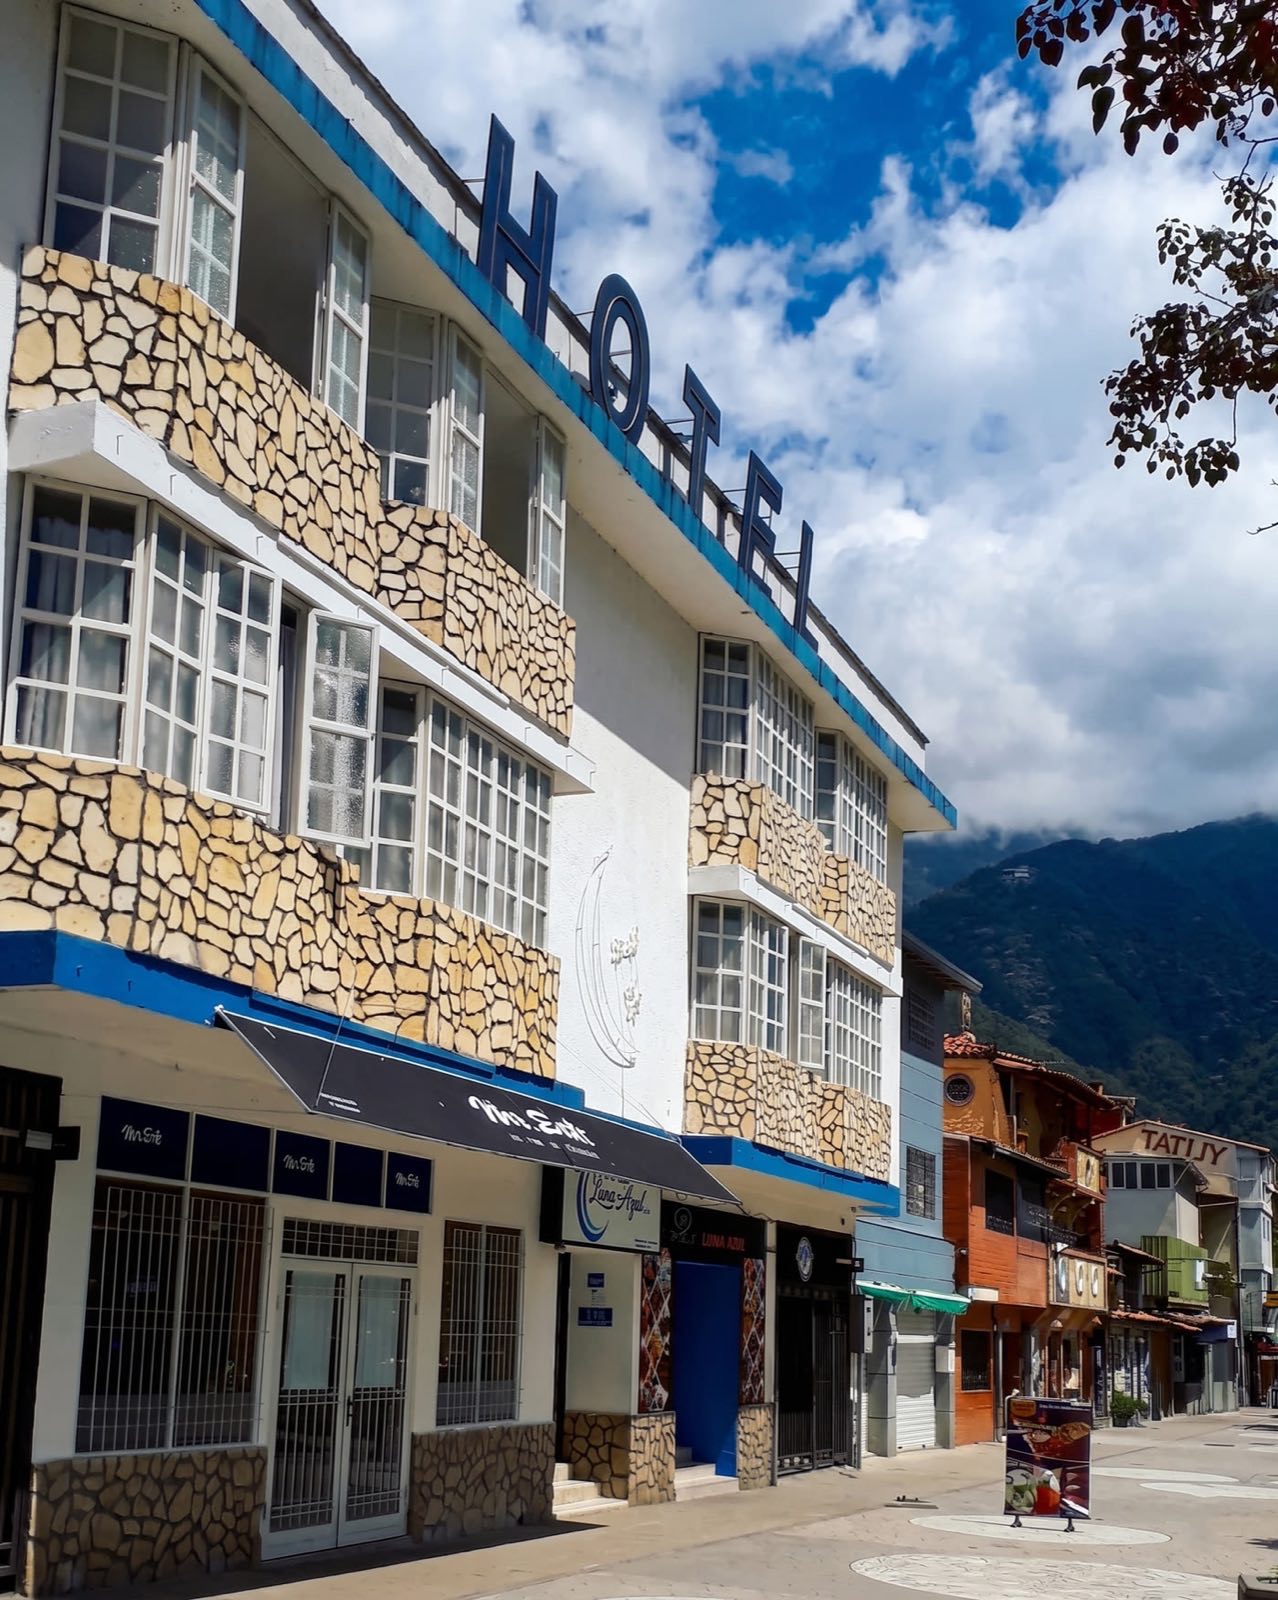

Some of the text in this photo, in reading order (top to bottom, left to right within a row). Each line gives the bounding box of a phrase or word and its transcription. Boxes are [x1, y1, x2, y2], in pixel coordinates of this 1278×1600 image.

[477, 112, 818, 653] HOTEL
[589, 1179, 647, 1221] Luna Azul
[702, 1232, 725, 1248] LUNA
[727, 1235, 746, 1251] AZUL
